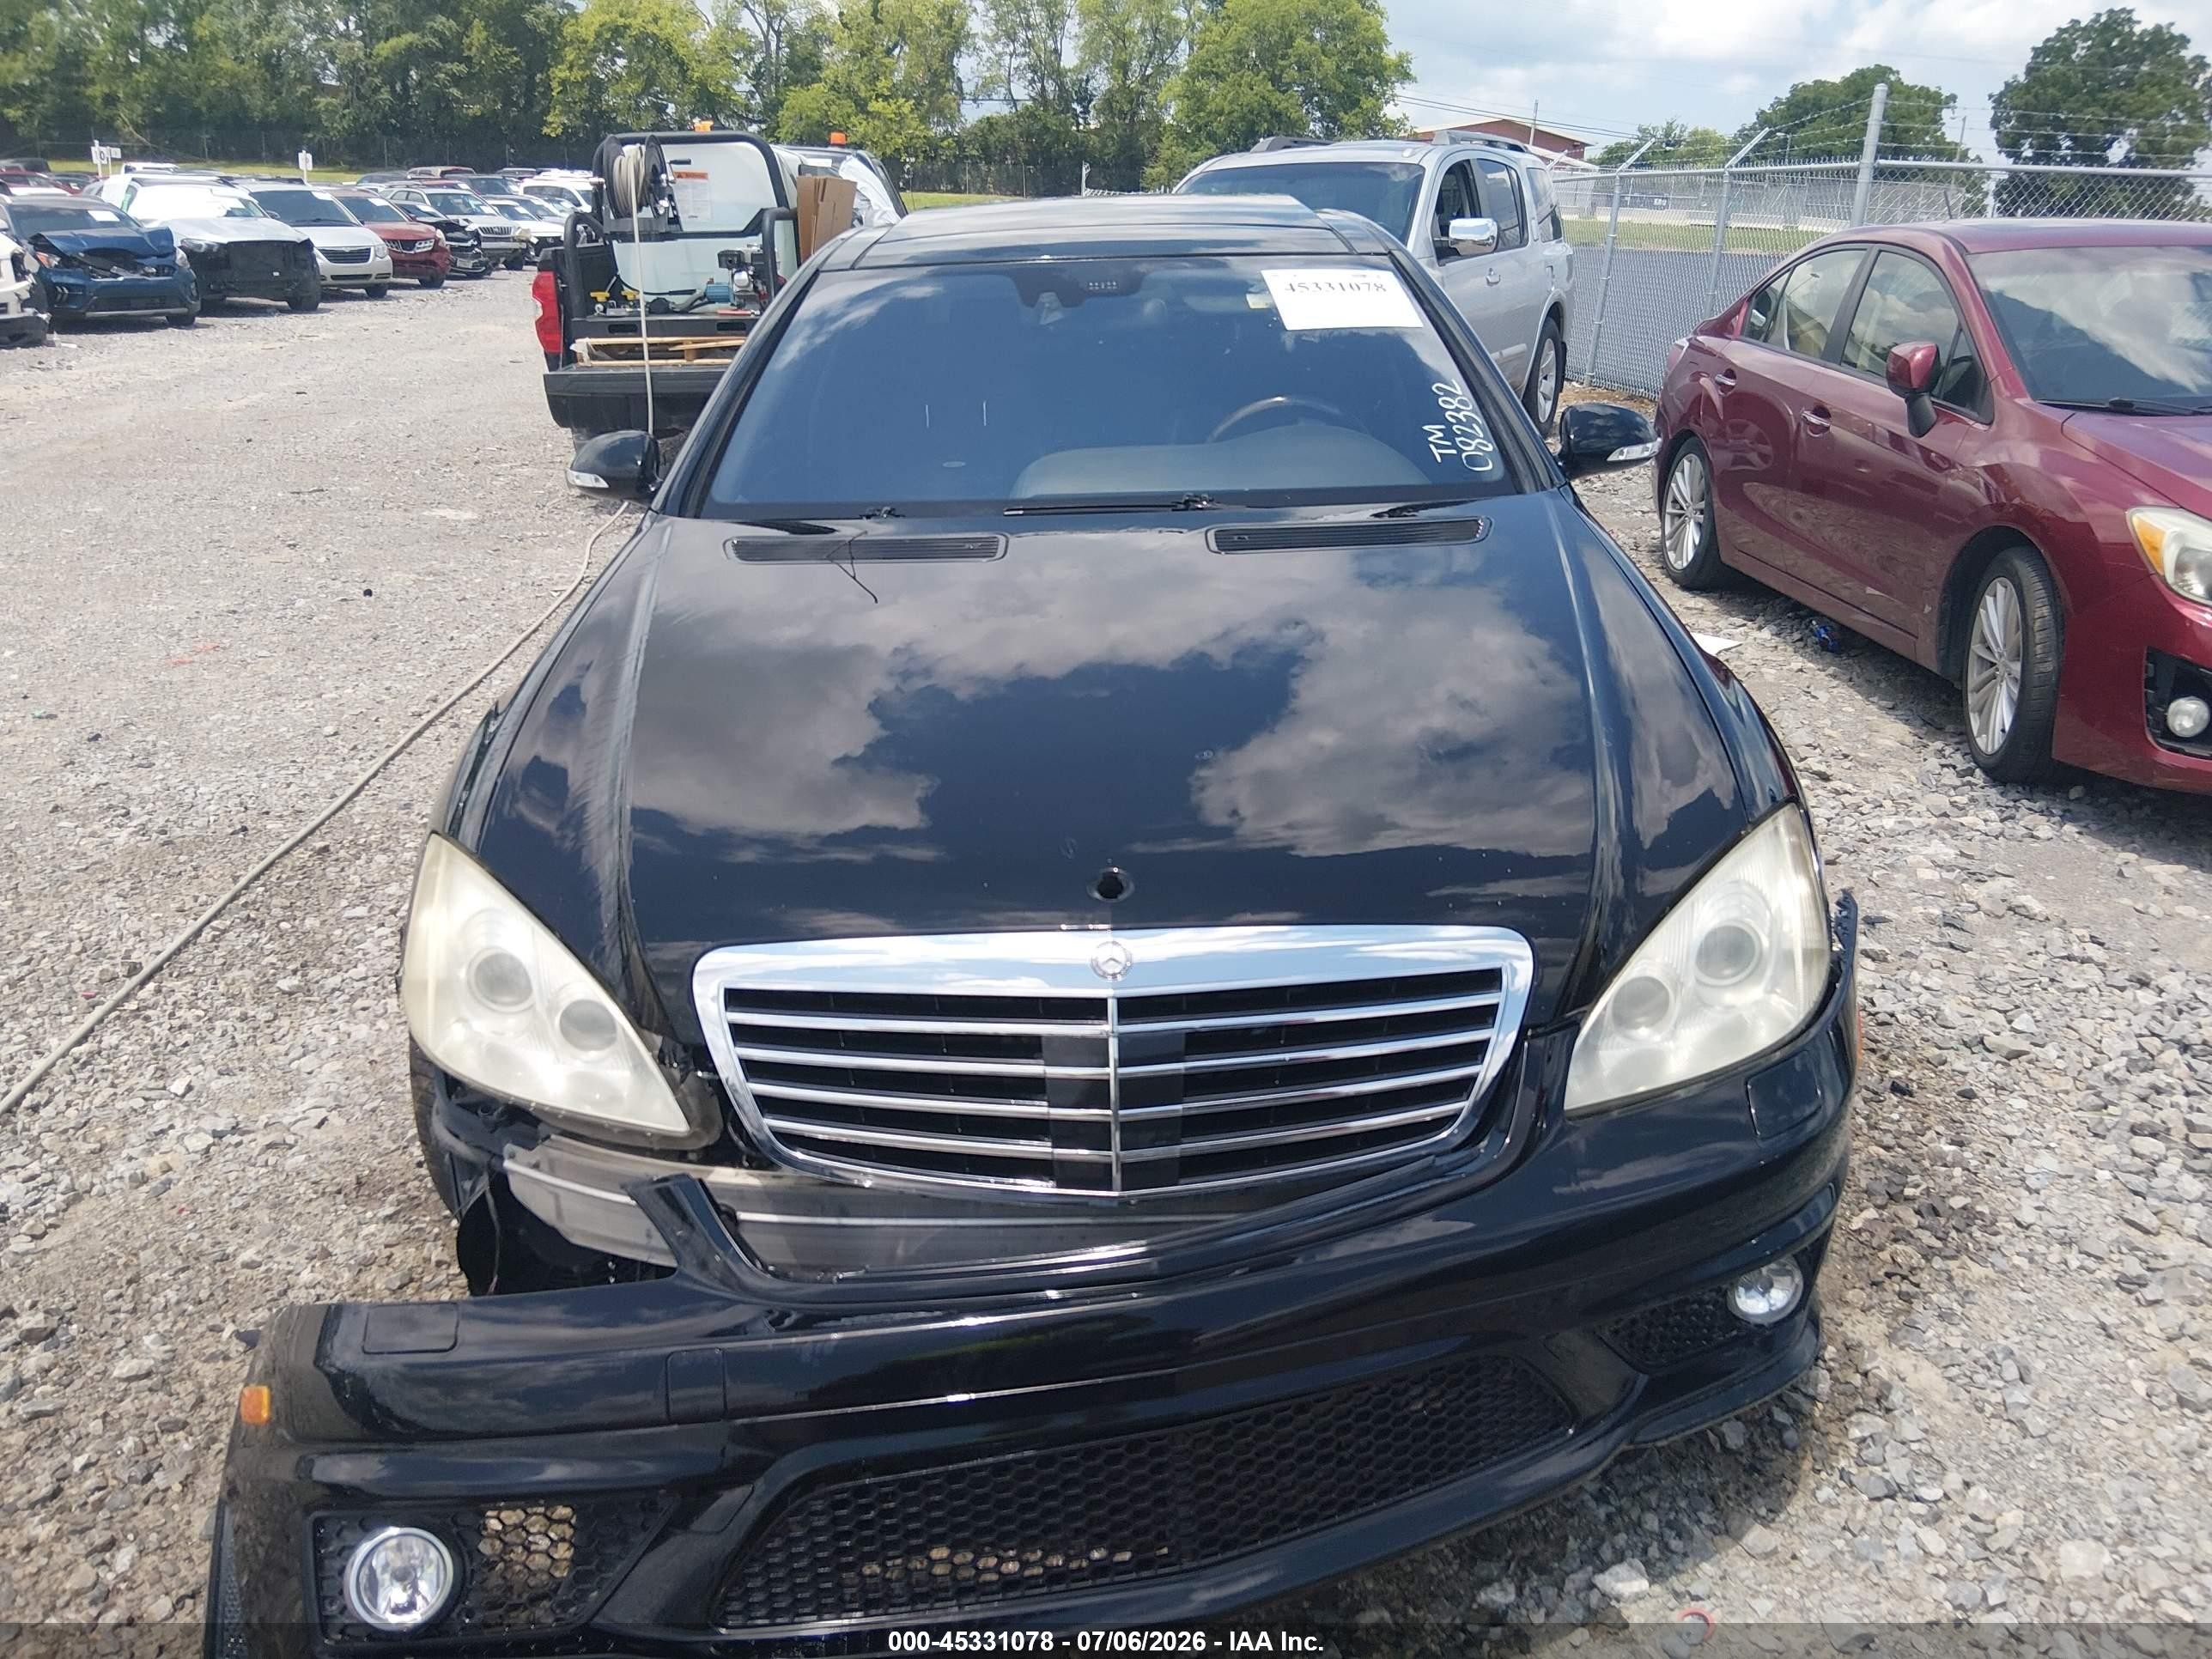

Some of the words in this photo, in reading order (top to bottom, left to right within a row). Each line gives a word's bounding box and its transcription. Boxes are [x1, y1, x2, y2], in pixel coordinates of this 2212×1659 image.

[1285, 282, 1388, 293] 45331078
[1422, 424, 1458, 464] TM
[1431, 379, 1494, 471] 082382
